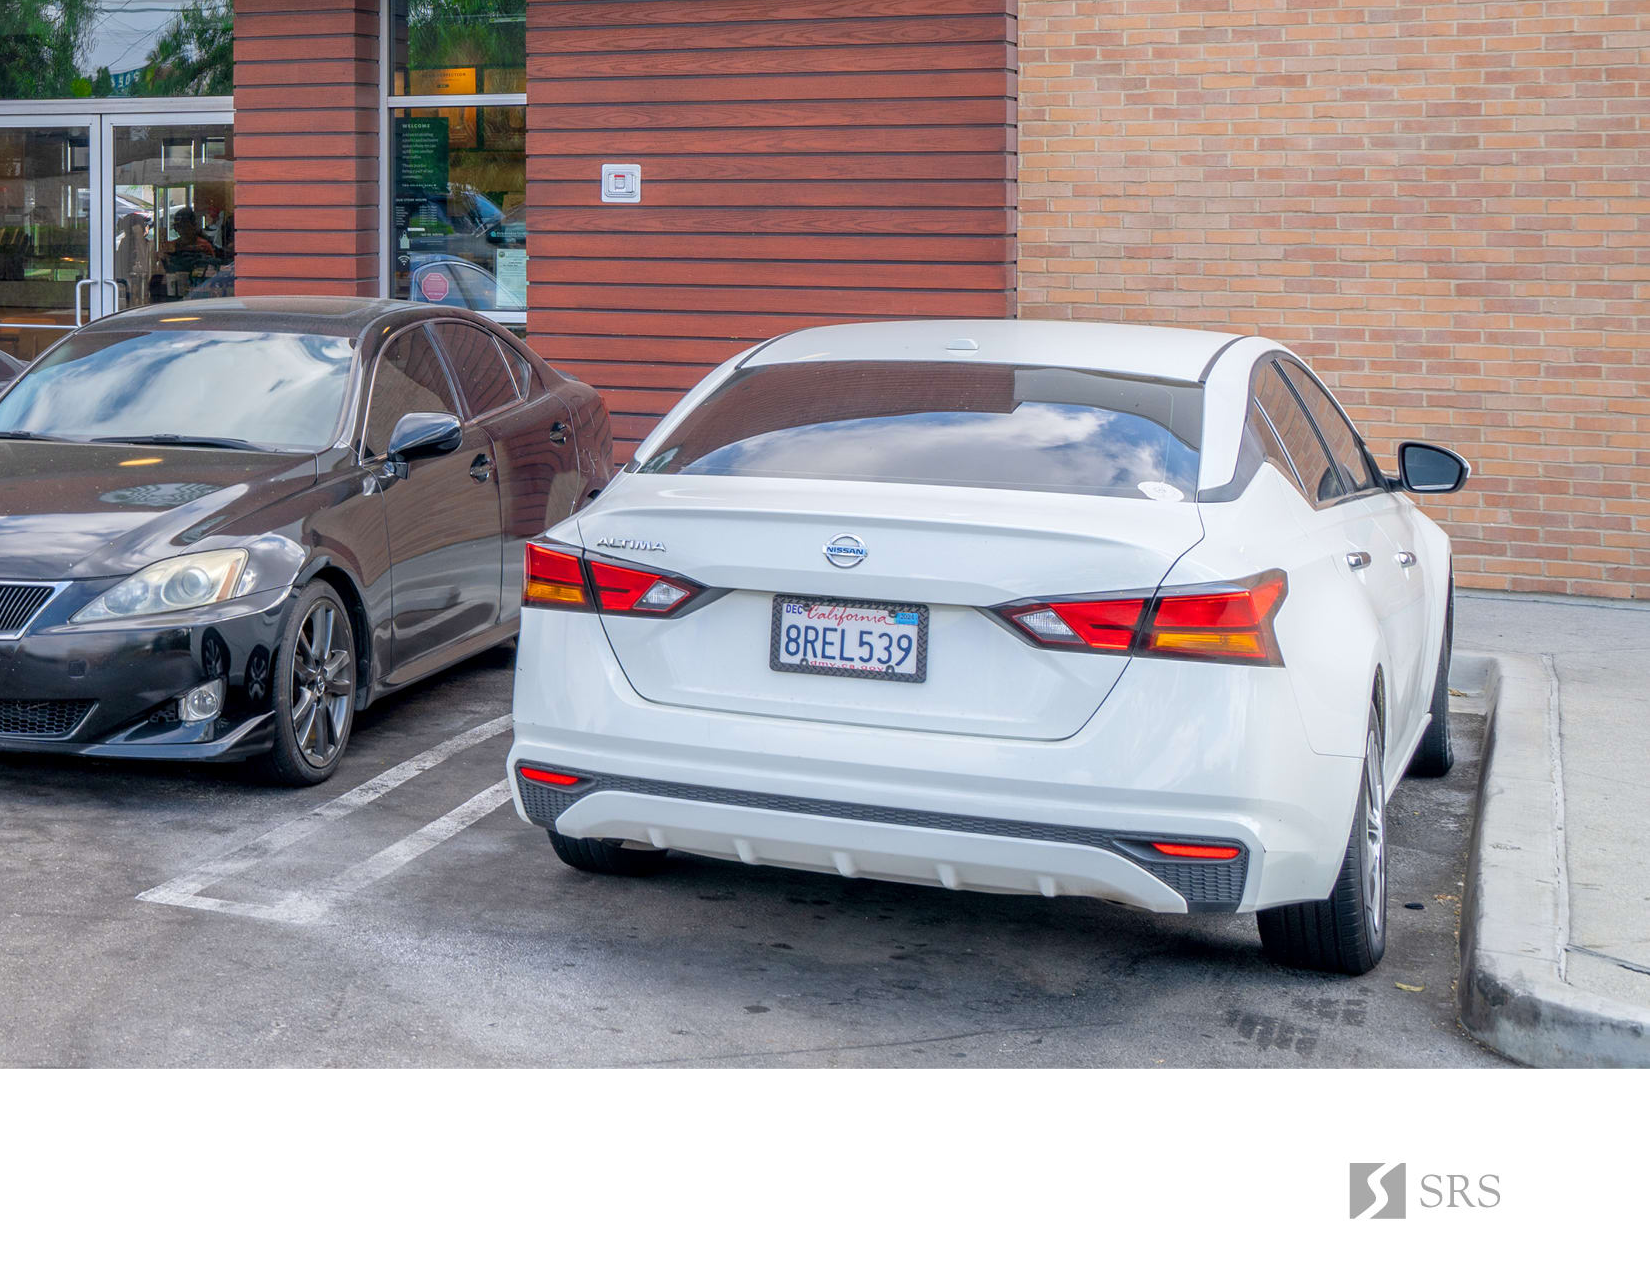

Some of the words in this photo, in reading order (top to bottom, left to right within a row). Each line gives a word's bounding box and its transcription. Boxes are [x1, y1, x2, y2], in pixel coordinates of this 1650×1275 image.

[597, 536, 667, 552] ALTIMA
[826, 546, 864, 555] NISSAN
[786, 603, 804, 615] DEC
[807, 604, 896, 627] California
[785, 624, 913, 667] 8REL539
